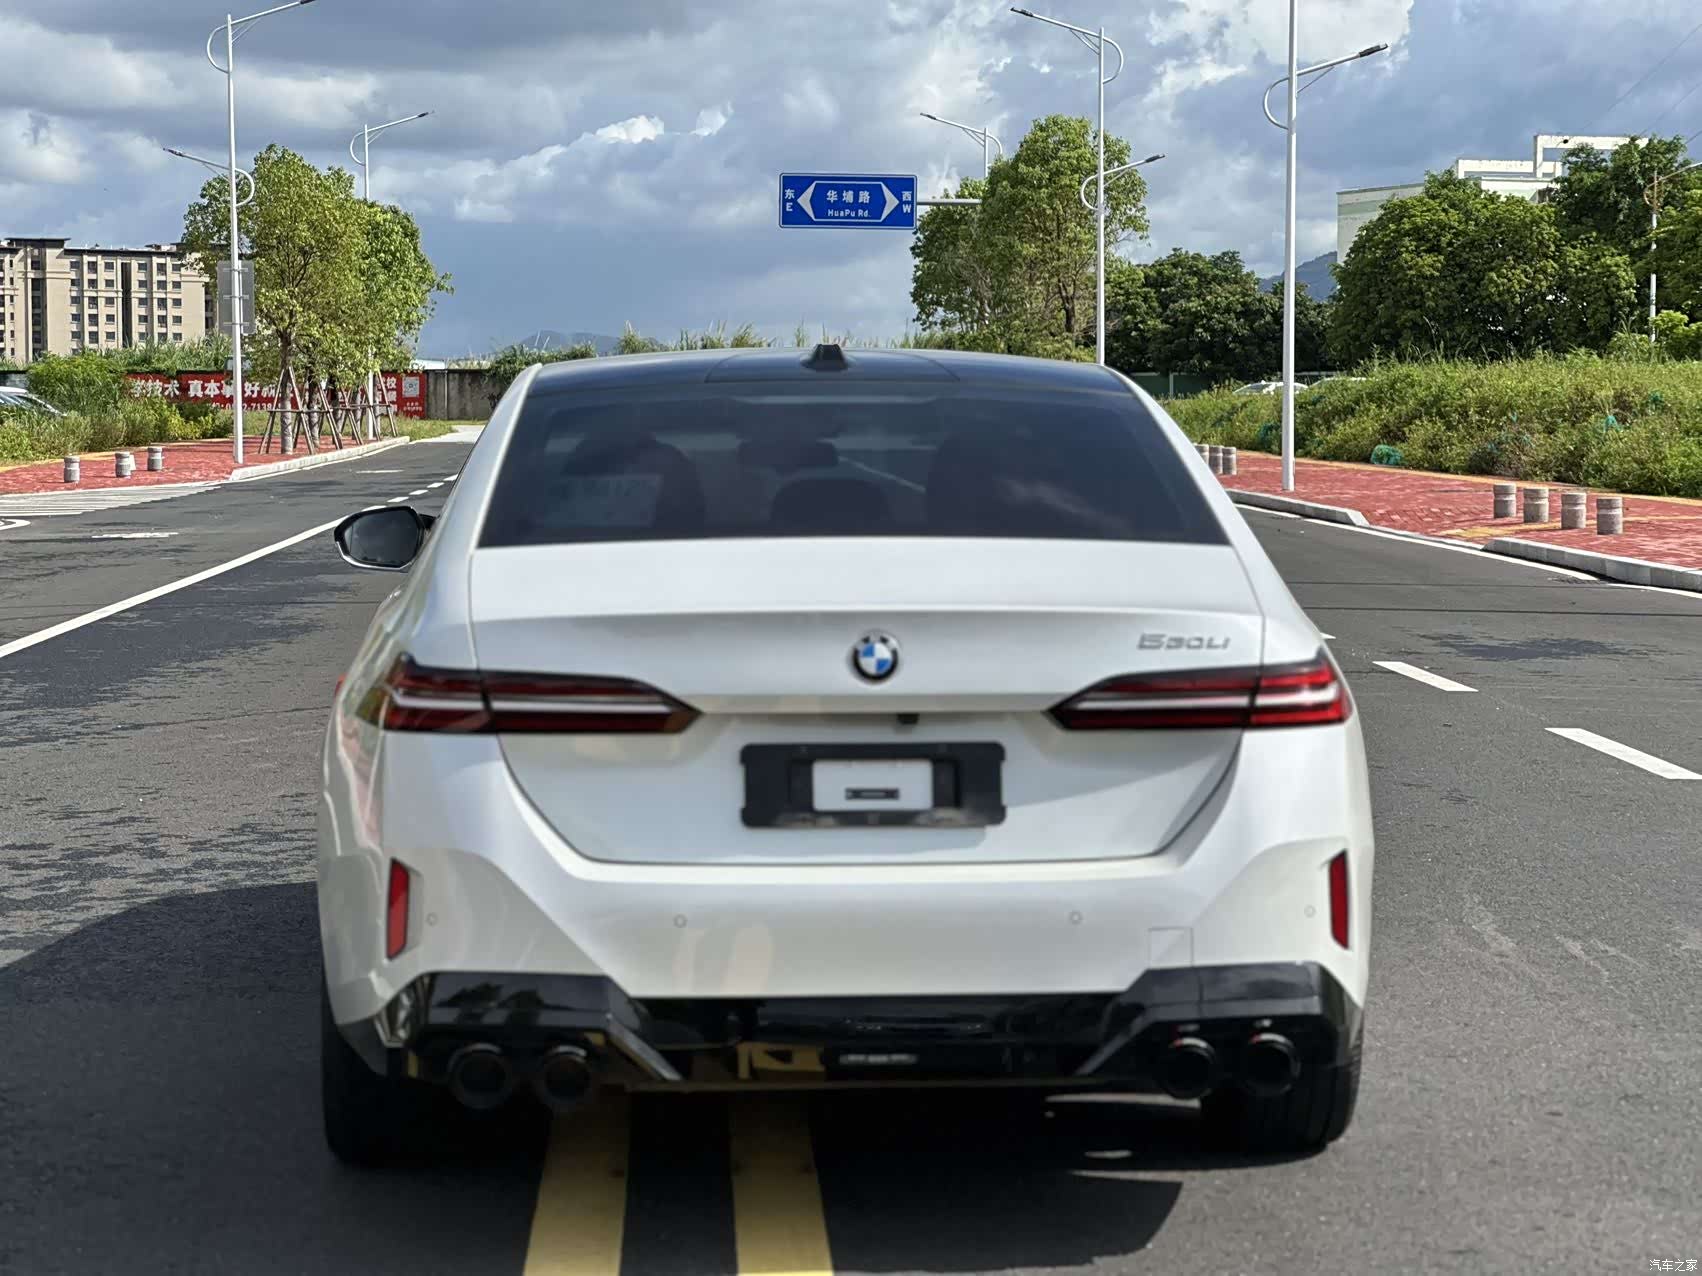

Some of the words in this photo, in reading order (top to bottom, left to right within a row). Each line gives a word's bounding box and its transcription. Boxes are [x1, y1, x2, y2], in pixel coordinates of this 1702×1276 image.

[784, 188, 795, 200] 东
[826, 190, 871, 204] 华埔路
[901, 191, 912, 202] 西
[786, 202, 793, 212] E
[902, 204, 912, 213] W
[827, 209, 855, 217] HuaPu
